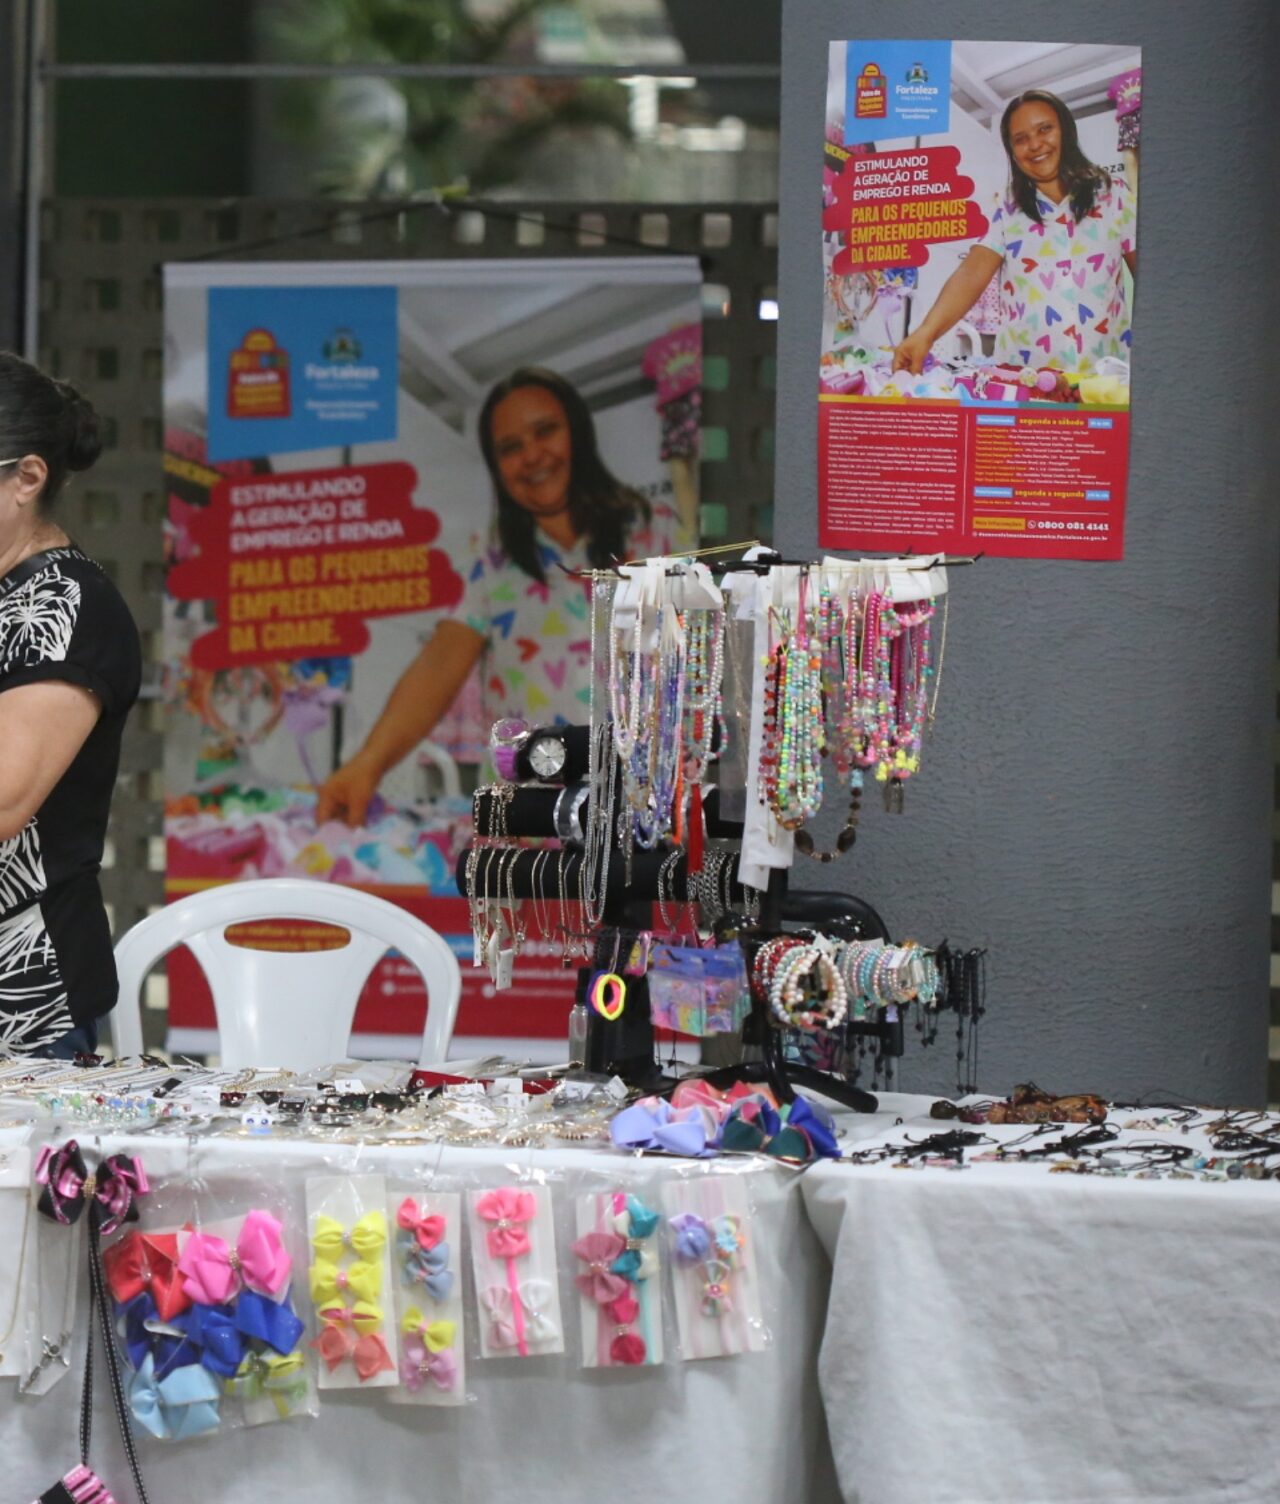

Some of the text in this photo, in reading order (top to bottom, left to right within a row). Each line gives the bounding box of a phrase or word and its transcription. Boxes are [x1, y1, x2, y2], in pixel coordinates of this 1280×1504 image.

[895, 85, 938, 95] Fortaleza
[854, 155, 929, 173] ESTIMULANDO
[854, 170, 929, 187] A GERAÇÃO DE
[853, 182, 951, 201] EMPREGO E RENDA
[851, 199, 967, 224] PARA OS PEQUENOS
[851, 219, 968, 244] EMPREENDEDORES
[851, 243, 912, 264] DA CIDADE.
[305, 363, 380, 380] Fortaleza
[230, 475, 367, 506] ESTIMULANDO
[1015, 489, 1047, 497] segunda
[1053, 490, 1085, 499] segunda
[230, 499, 367, 528] A GERAÇÃO DE
[230, 519, 404, 553] EMPREGO E RENDA
[1037, 521, 1065, 530] 0800
[1066, 521, 1085, 530] 081
[1086, 522, 1109, 531] 4141
[230, 545, 430, 588] PARA OS PEQUENOS
[229, 577, 431, 621] EMPREENDEDORES
[229, 618, 341, 653] DA CIDADE.
